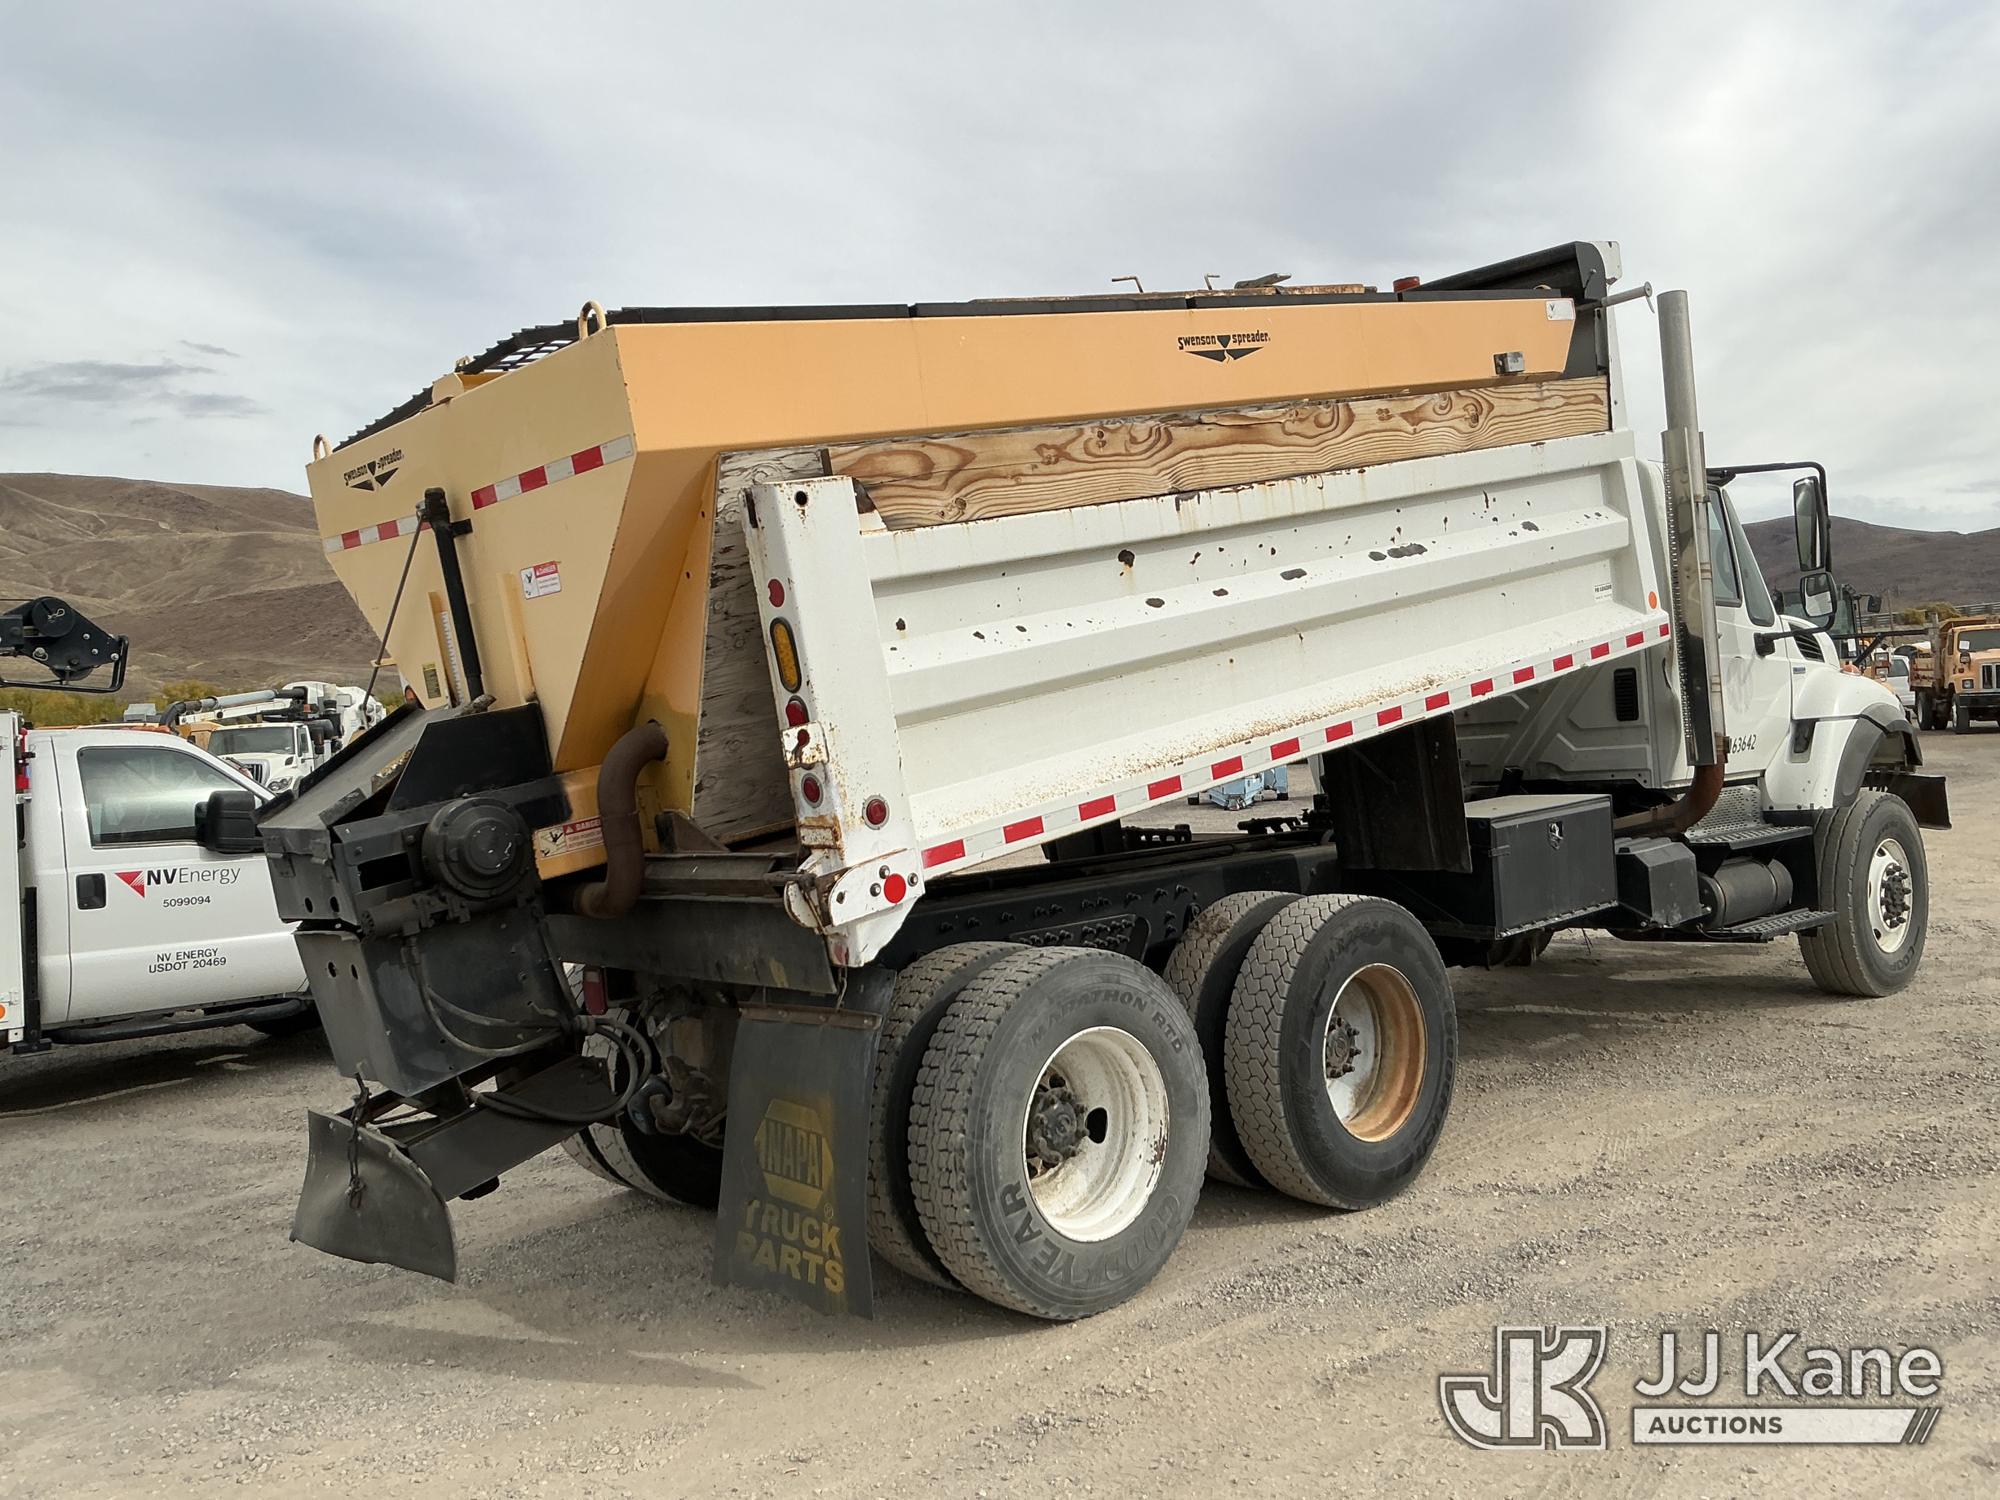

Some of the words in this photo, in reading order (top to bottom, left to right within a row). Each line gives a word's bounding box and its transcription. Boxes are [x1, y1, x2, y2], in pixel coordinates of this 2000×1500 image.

[1177, 334, 1217, 350] Swenson
[162, 895, 212, 908] 5099094
[156, 953, 172, 963] NV
[175, 948, 219, 961] ENERGY
[148, 961, 189, 974] USDOT
[192, 956, 228, 970] 20469
[744, 1199, 841, 1258] TRUCK
[735, 1231, 845, 1293] PARTS
